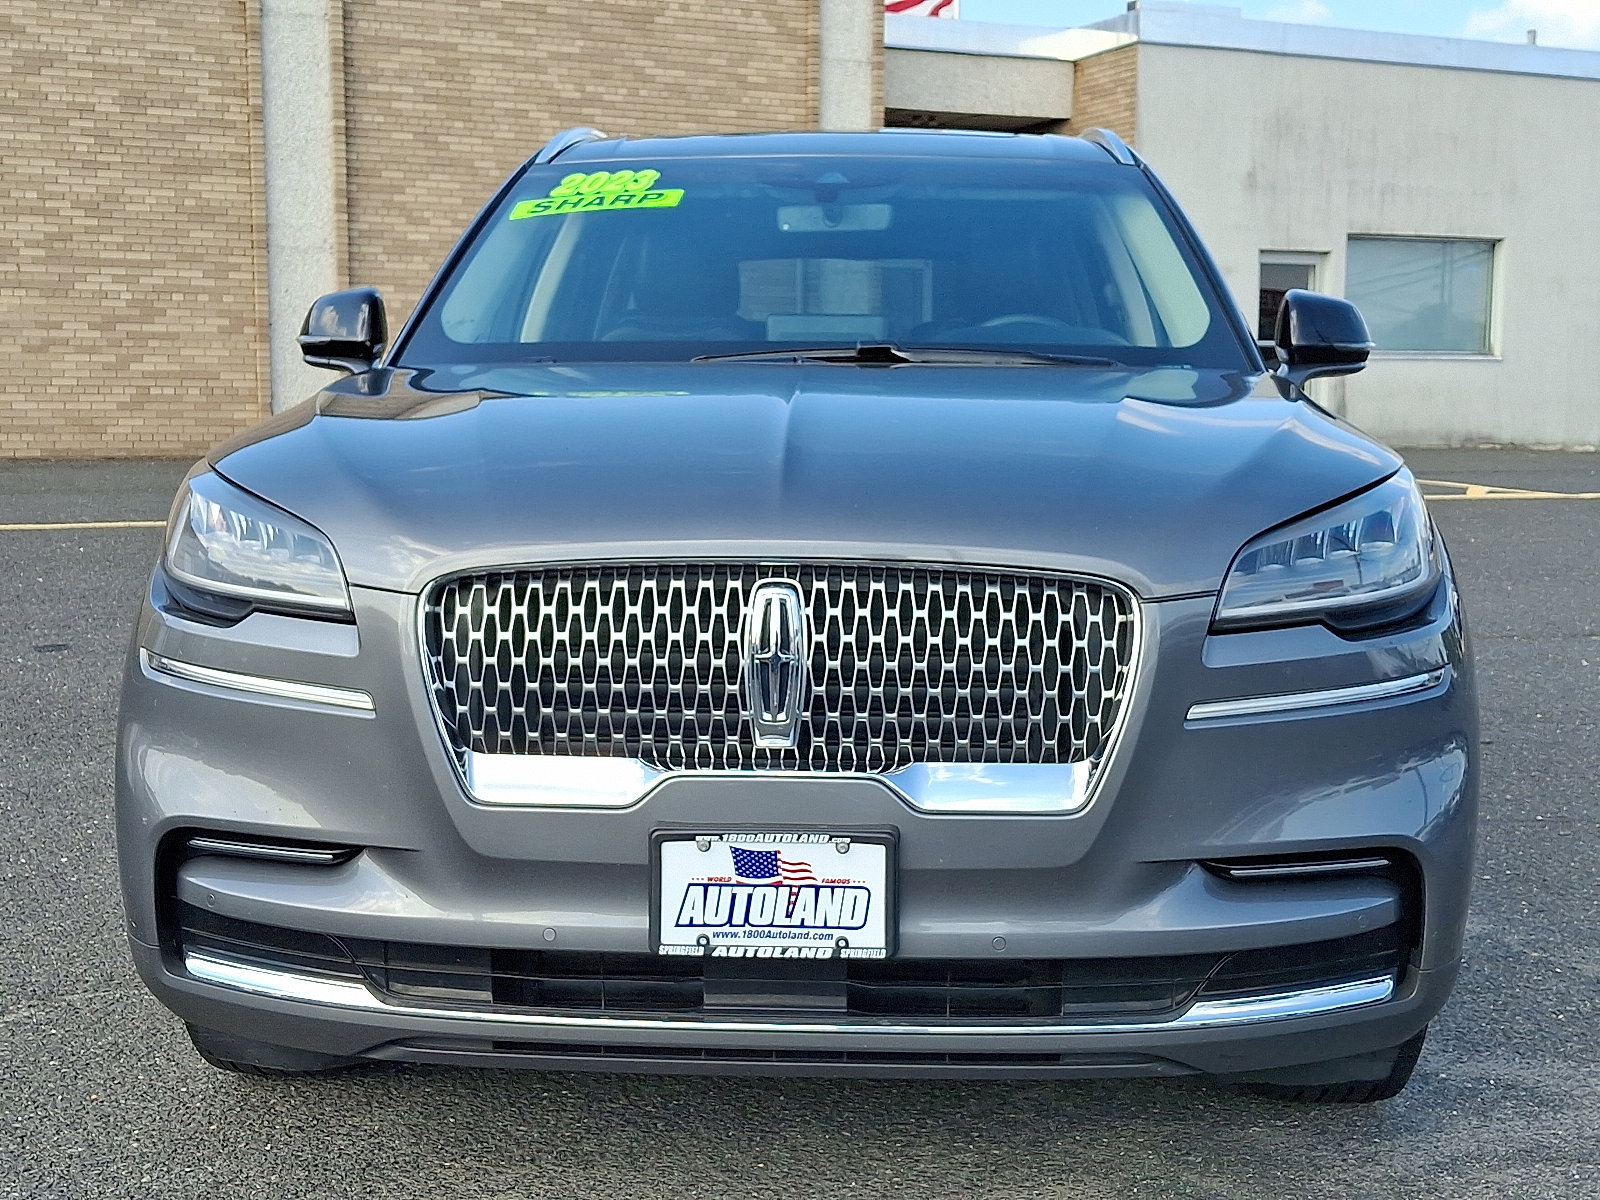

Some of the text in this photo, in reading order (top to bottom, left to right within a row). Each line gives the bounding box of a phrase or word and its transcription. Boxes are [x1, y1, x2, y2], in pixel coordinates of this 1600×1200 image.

[550, 169, 661, 197] 2023
[528, 193, 665, 214] SHARP
[674, 883, 871, 930] AUTOLAND
[712, 930, 834, 941] www.1800Autoland.com
[659, 945, 887, 959] SPRINGFIELD AUTOLAND SPRINGFIELD
